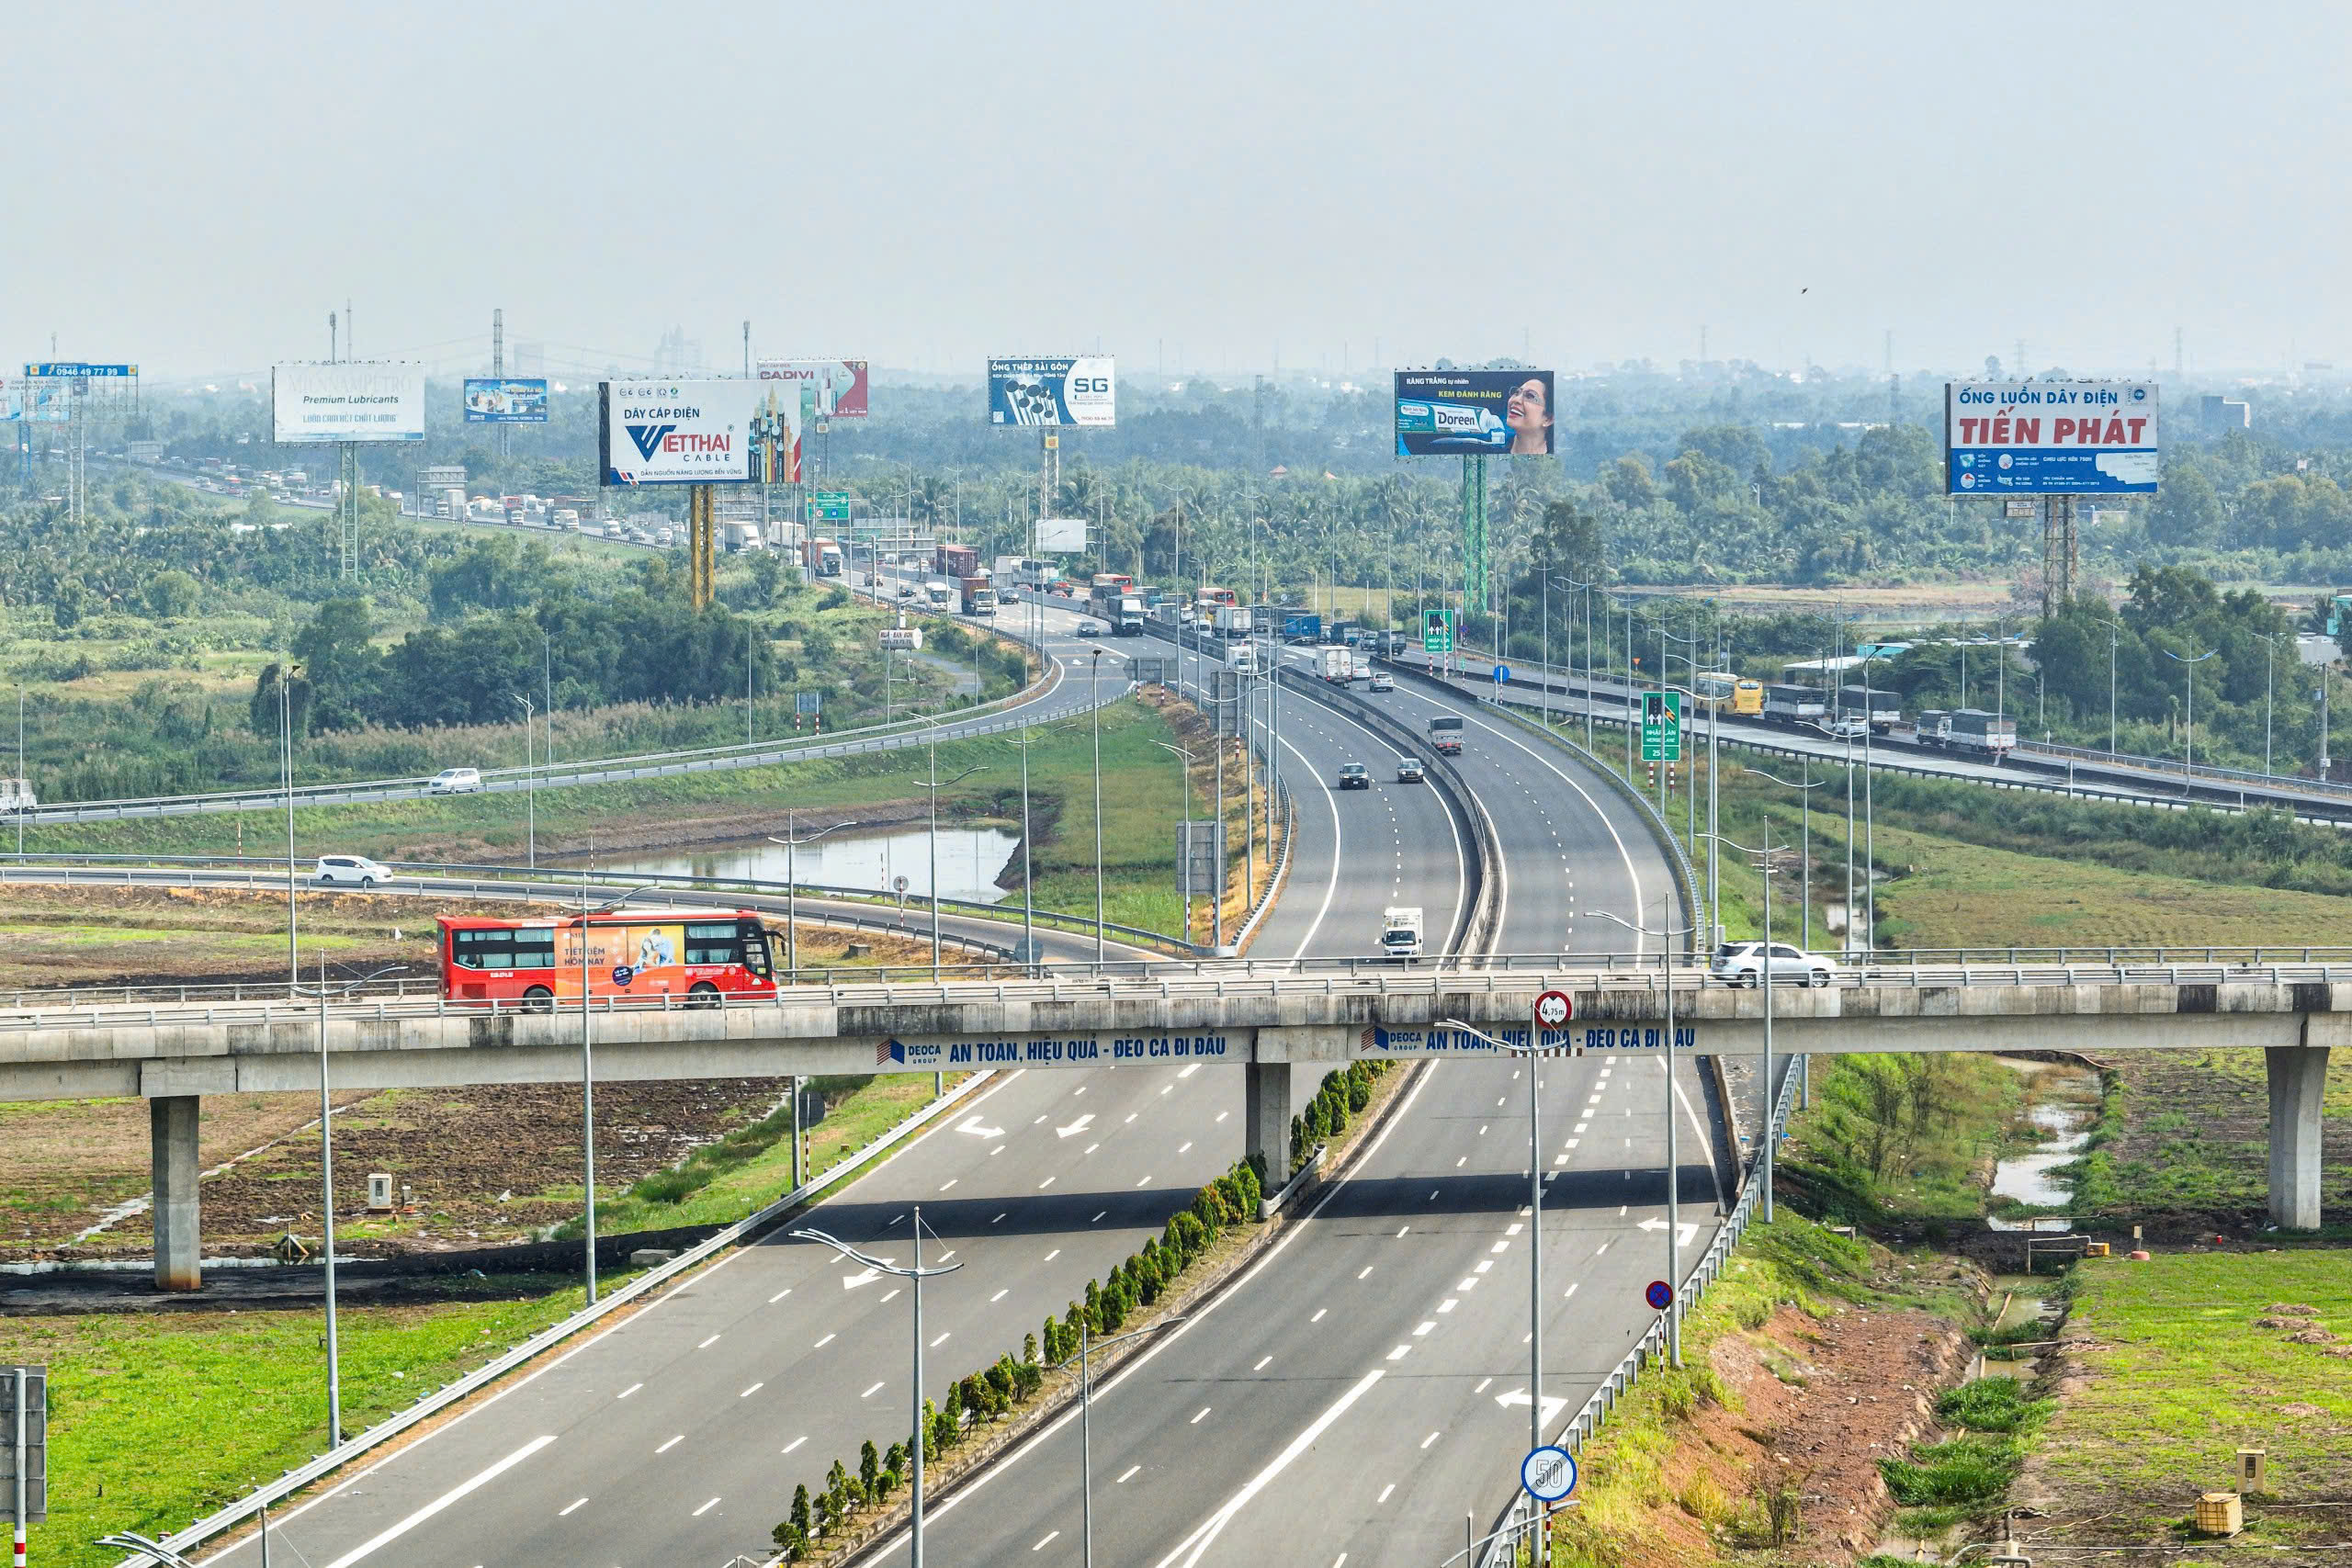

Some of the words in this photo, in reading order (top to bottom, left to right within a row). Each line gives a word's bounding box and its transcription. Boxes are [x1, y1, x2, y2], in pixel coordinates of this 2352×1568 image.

[991, 360, 1010, 371] ỐNG
[1035, 361, 1047, 371] SÀI
[1050, 361, 1069, 371] GÒN
[80, 367, 91, 376] 49
[94, 367, 104, 376] 77
[760, 370, 814, 379] CADIVI
[1074, 378, 1108, 392] SG
[1425, 377, 1447, 385] TRẮNG
[302, 394, 345, 404] Premium
[347, 394, 399, 404] Lubricants
[1456, 389, 1478, 398] ĐÁNH
[1481, 390, 1502, 399] RĂNG
[1959, 387, 1995, 404] ỐNG
[2001, 386, 2041, 404] LUỒN
[2046, 389, 2077, 404] DÂY
[2084, 389, 2118, 407] ĐIỆN
[624, 408, 646, 419] DÂY
[649, 407, 671, 419] CÁP
[673, 406, 700, 421] ĐIỆN
[1437, 411, 1476, 426] Doreen
[1959, 406, 2041, 444] TIẾN
[2053, 410, 2147, 444] PHÁT
[683, 454, 730, 462] CABLE
[588, 957, 605, 965] NAY
[1389, 1032, 1422, 1043] DEOCA
[1426, 1031, 1448, 1050] AN
[1645, 1028, 1660, 1047] ĐI
[908, 1044, 942, 1055] DEOCA
[949, 1043, 972, 1063] AN
[977, 1037, 1023, 1063] TOÀN,
[1027, 1035, 1063, 1066] HIỆU
[1067, 1032, 1099, 1062] QUẢ
[1114, 1033, 1145, 1058] ĐÈO
[1148, 1031, 1170, 1057] CẢ
[1174, 1037, 1190, 1056] ĐI
[1193, 1029, 1226, 1055] ĐẦU
[1535, 1459, 1563, 1488] 50
